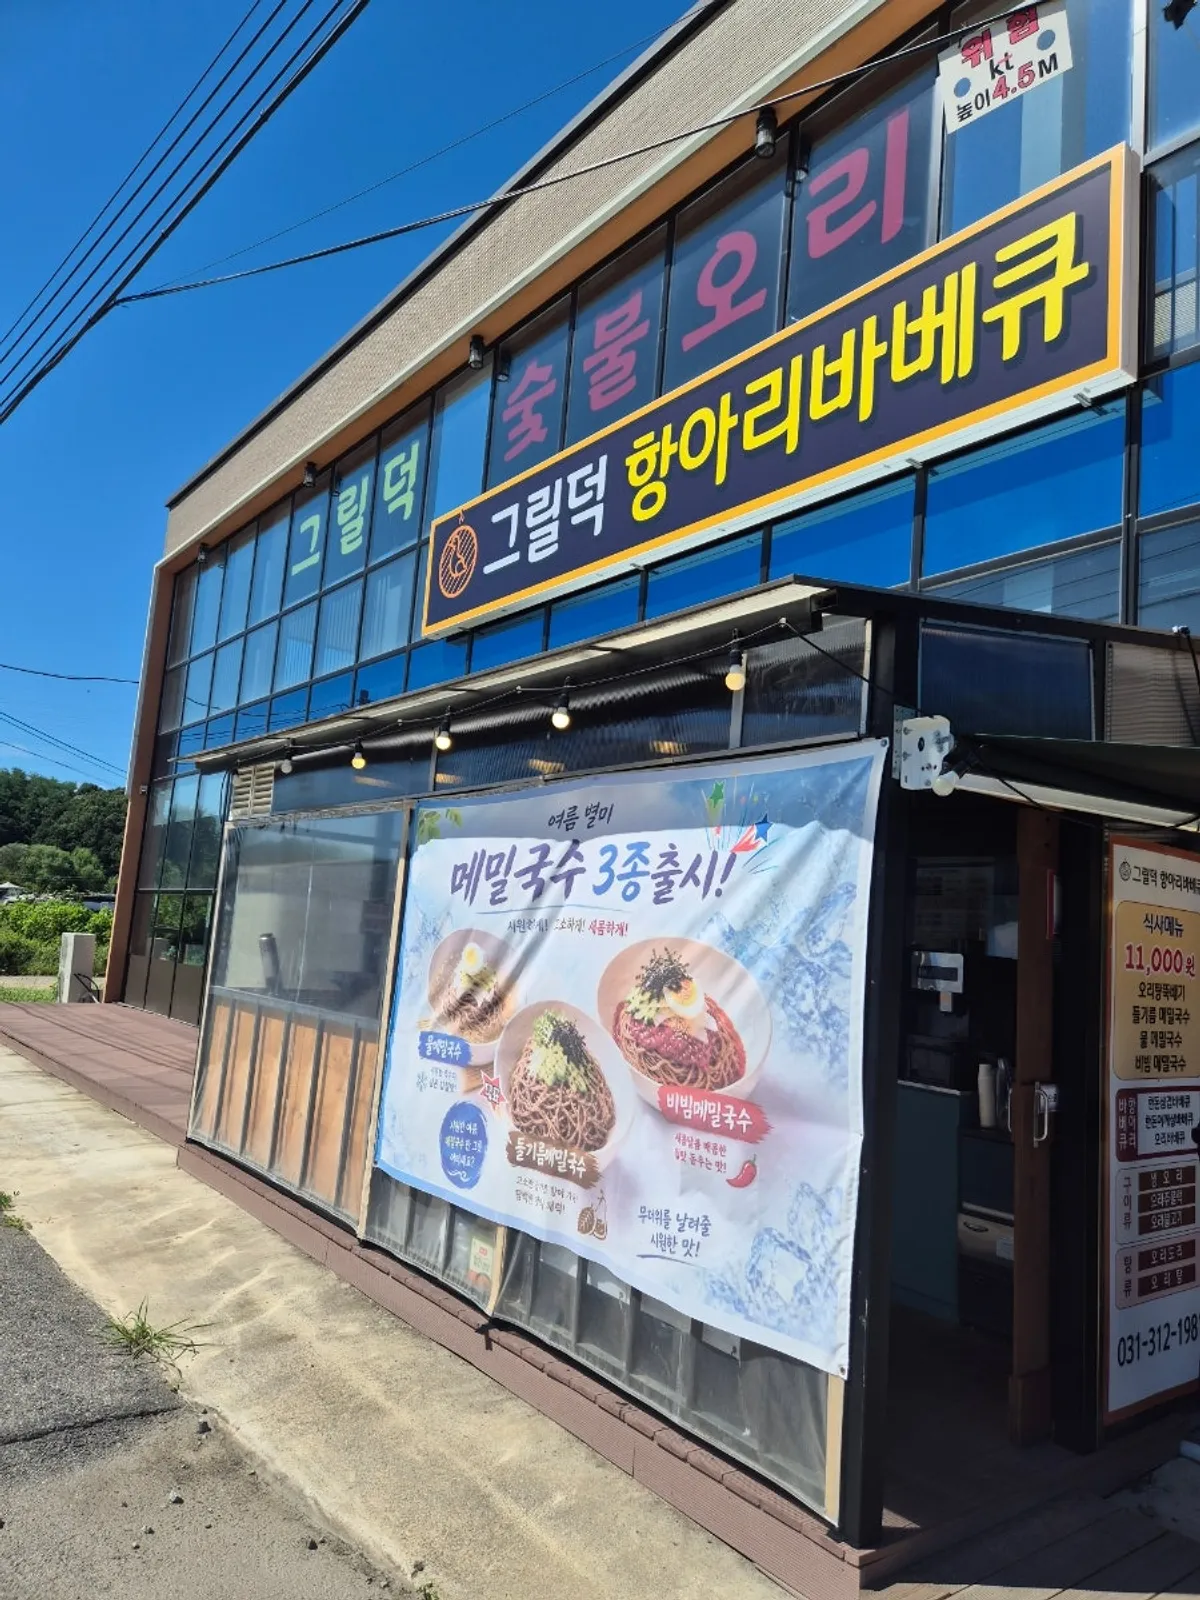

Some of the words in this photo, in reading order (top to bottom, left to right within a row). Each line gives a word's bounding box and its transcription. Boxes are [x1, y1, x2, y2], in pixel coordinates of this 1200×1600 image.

[483, 455, 609, 575] 그릴덕
[626, 211, 1090, 522] 항아리바베큐
[291, 441, 420, 576] 그릴덕
[548, 804, 580, 832] 여름
[584, 801, 614, 827] 별미
[450, 839, 587, 906] 메밀국수
[1132, 866, 1157, 887] 그릴덕
[1143, 913, 1184, 938] 식사메뉴
[1132, 1005, 1156, 1025] 들기름
[1135, 1055, 1151, 1073] 비빔
[667, 1091, 753, 1134] 비빔메밀국수
[515, 1137, 586, 1179] 들기름메밀국수
[638, 1205, 672, 1231] 무더위를
[676, 1212, 712, 1237] 날려줄
[650, 1232, 678, 1255] 시원한
[682, 1238, 700, 1258] 맛!
[1117, 1313, 1200, 1367] 031-312-198
